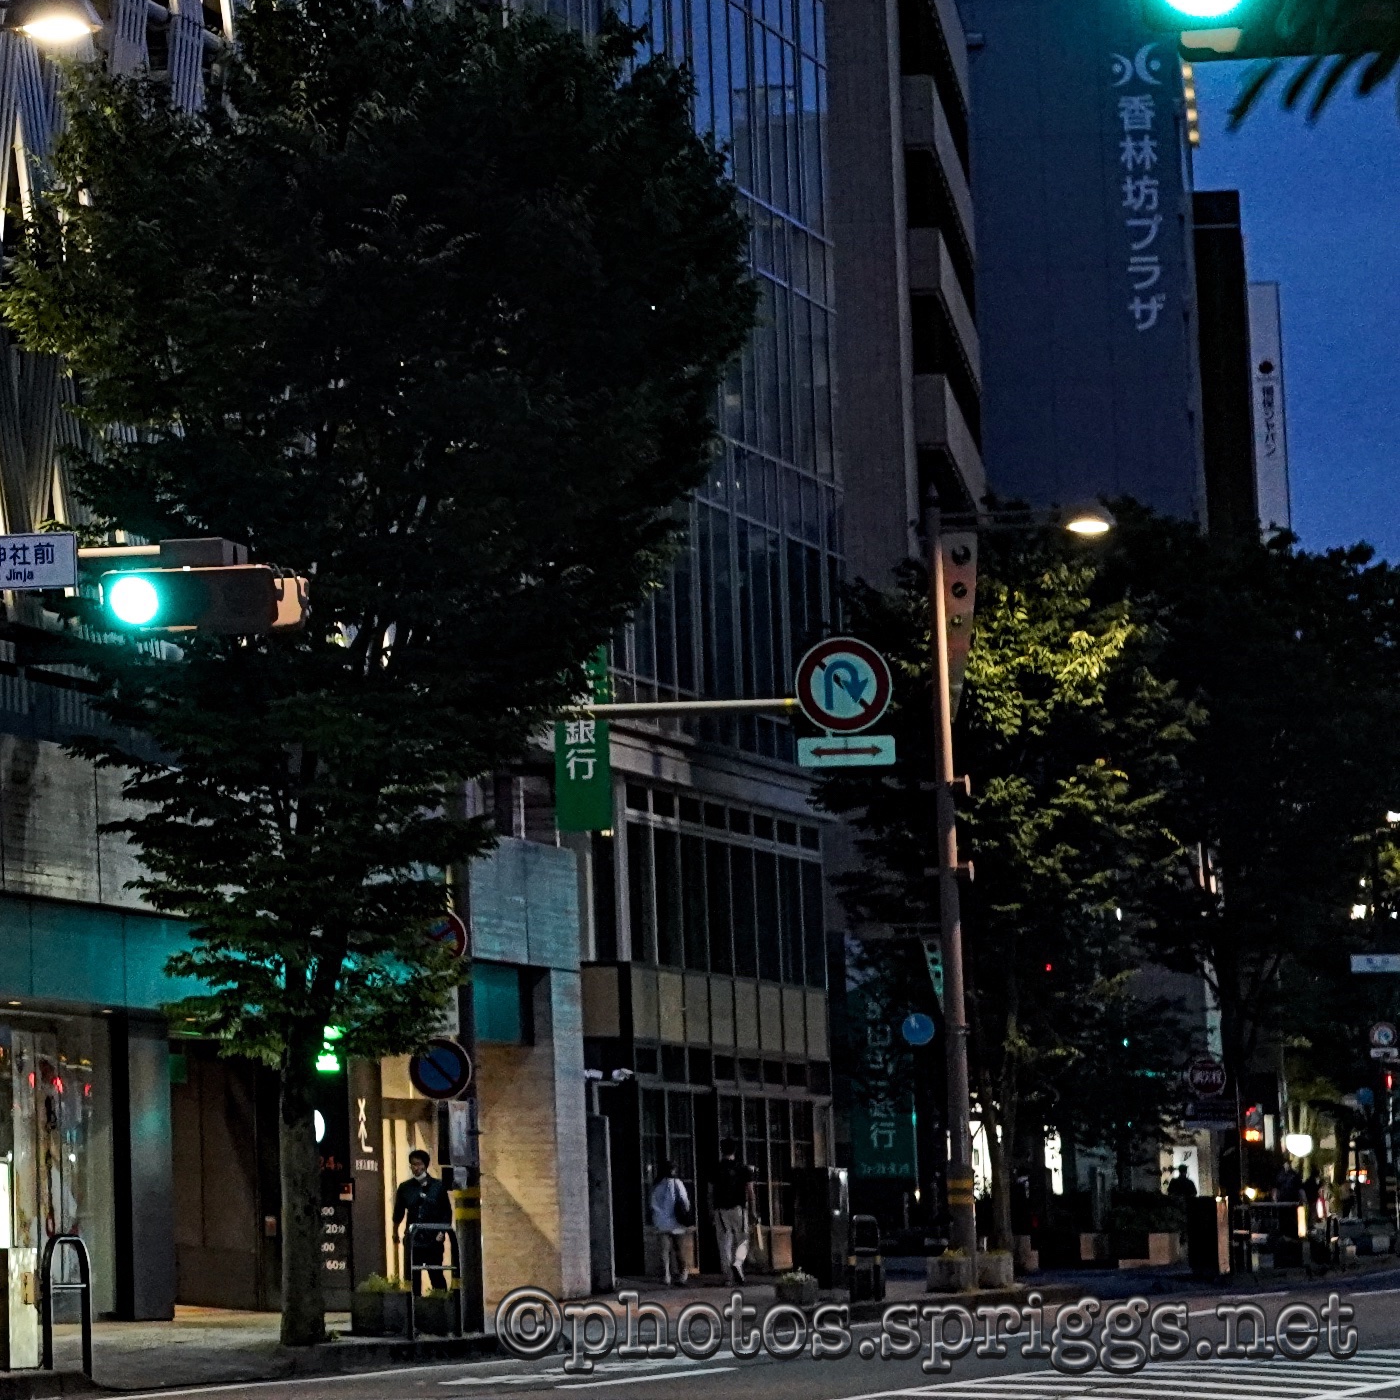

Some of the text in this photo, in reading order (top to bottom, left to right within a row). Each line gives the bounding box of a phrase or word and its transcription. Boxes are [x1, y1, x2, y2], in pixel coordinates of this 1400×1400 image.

[1117, 94, 1166, 332] 香林坊プラザ
[6, 569, 34, 583] Jinja
